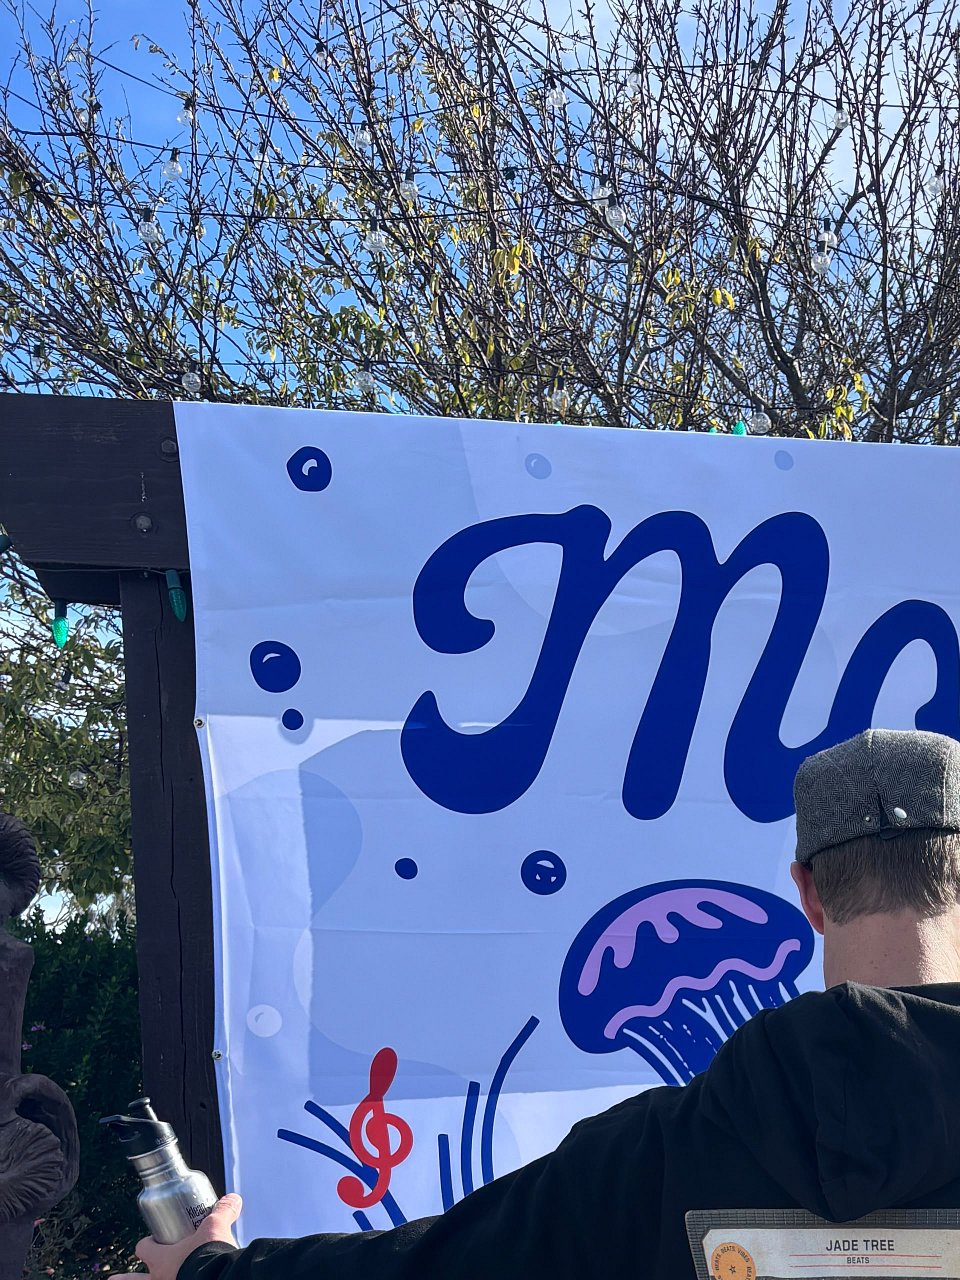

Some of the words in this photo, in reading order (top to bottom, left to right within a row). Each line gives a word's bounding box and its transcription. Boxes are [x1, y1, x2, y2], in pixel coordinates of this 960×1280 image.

[826, 1239, 859, 1252] JADE
[863, 1239, 895, 1251] TREE
[846, 1256, 870, 1264] BEATS
